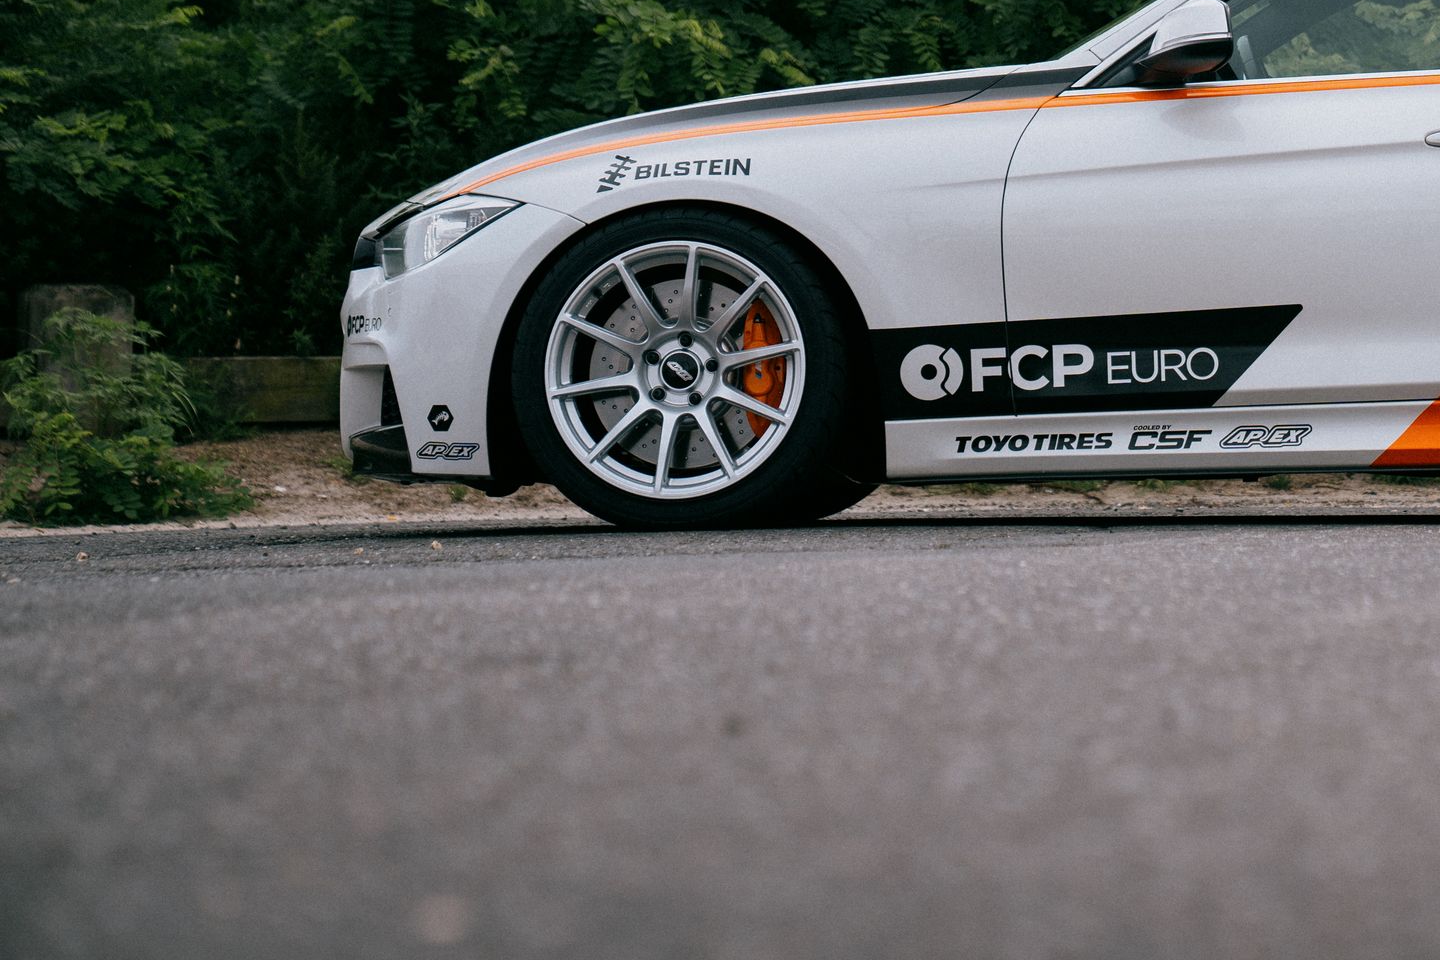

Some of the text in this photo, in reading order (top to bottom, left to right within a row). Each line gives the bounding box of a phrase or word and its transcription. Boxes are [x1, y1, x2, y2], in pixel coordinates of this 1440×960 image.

[634, 158, 752, 181] BILSTEIN
[969, 343, 1220, 393] FCP EURO
[1127, 429, 1213, 451] CSF
[1222, 426, 1309, 447] APEX
[418, 443, 477, 459] APEX
